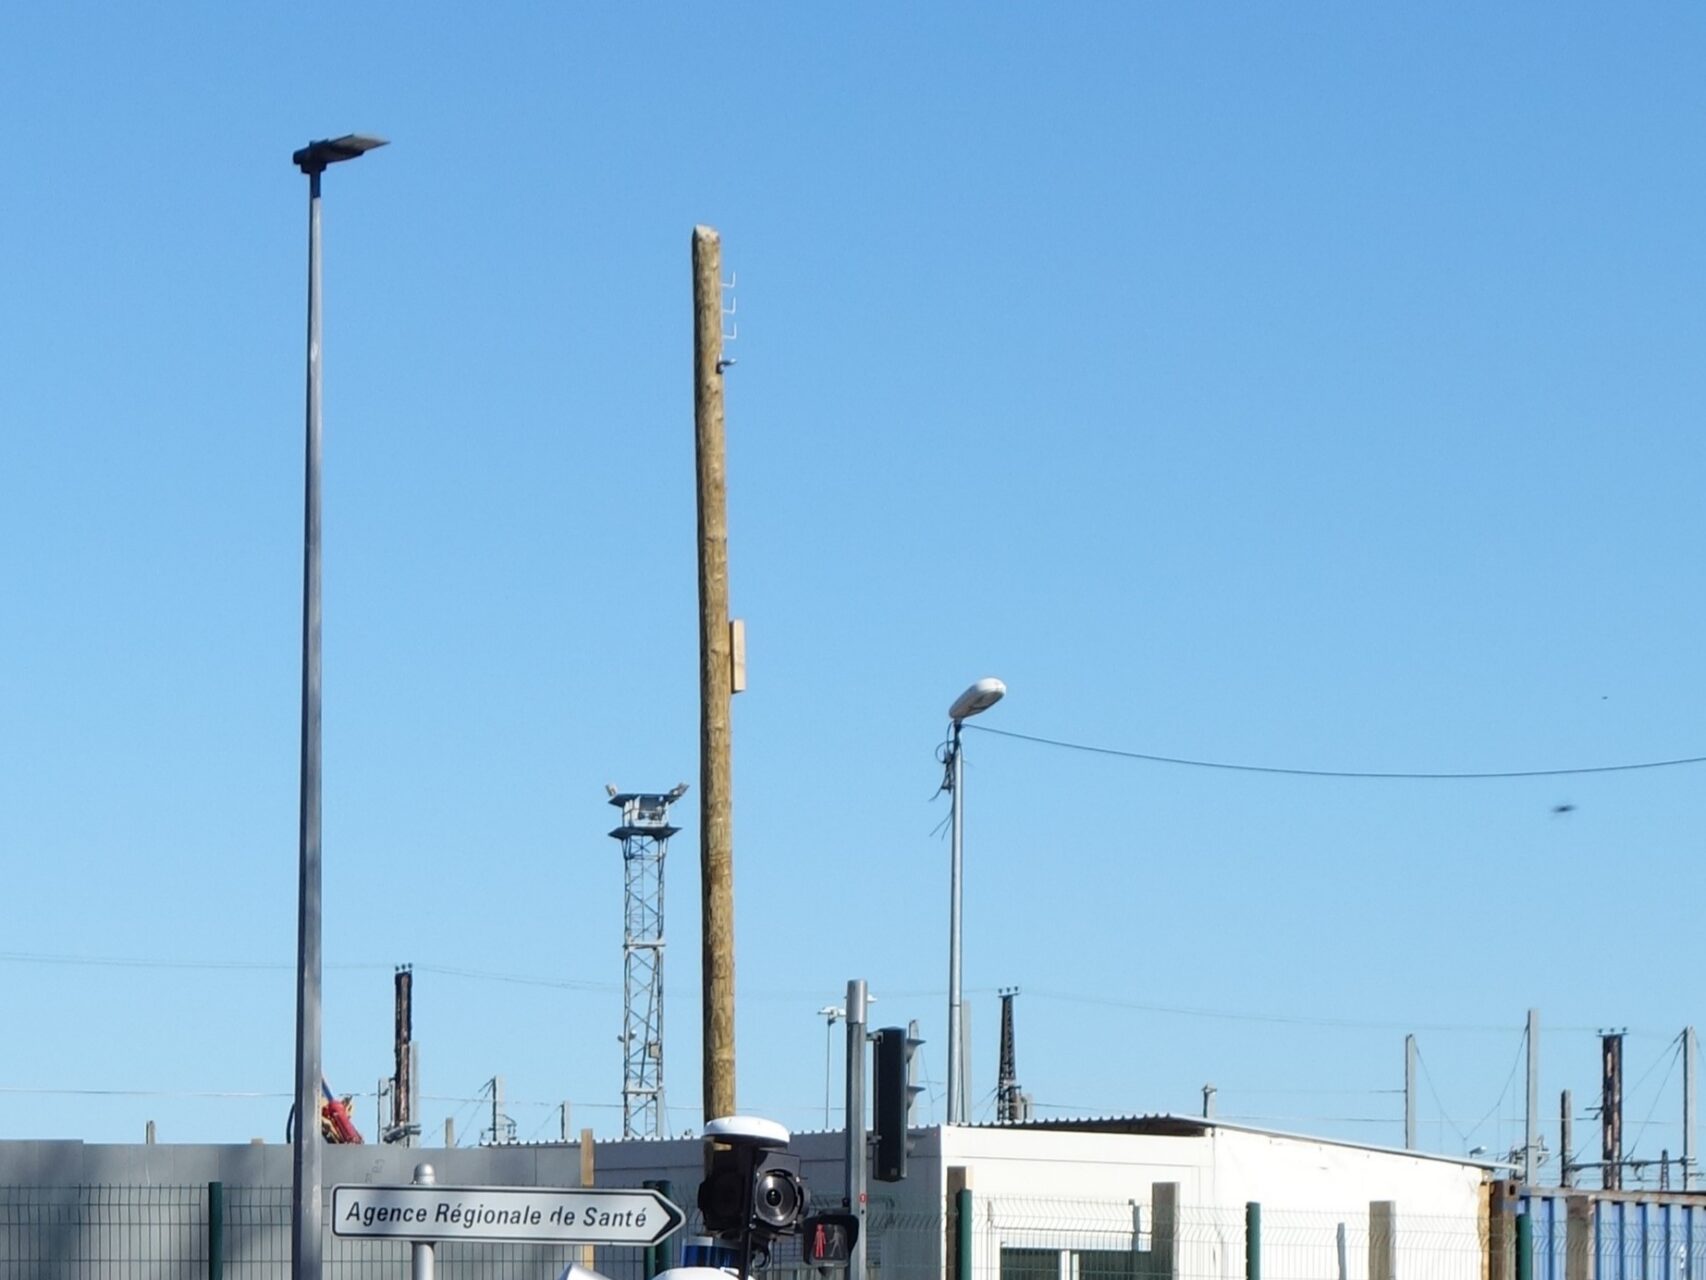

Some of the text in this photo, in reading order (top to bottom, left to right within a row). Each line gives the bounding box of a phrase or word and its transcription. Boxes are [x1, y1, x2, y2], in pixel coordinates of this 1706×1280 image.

[345, 1201, 648, 1229] Agence Régionale de Santé
